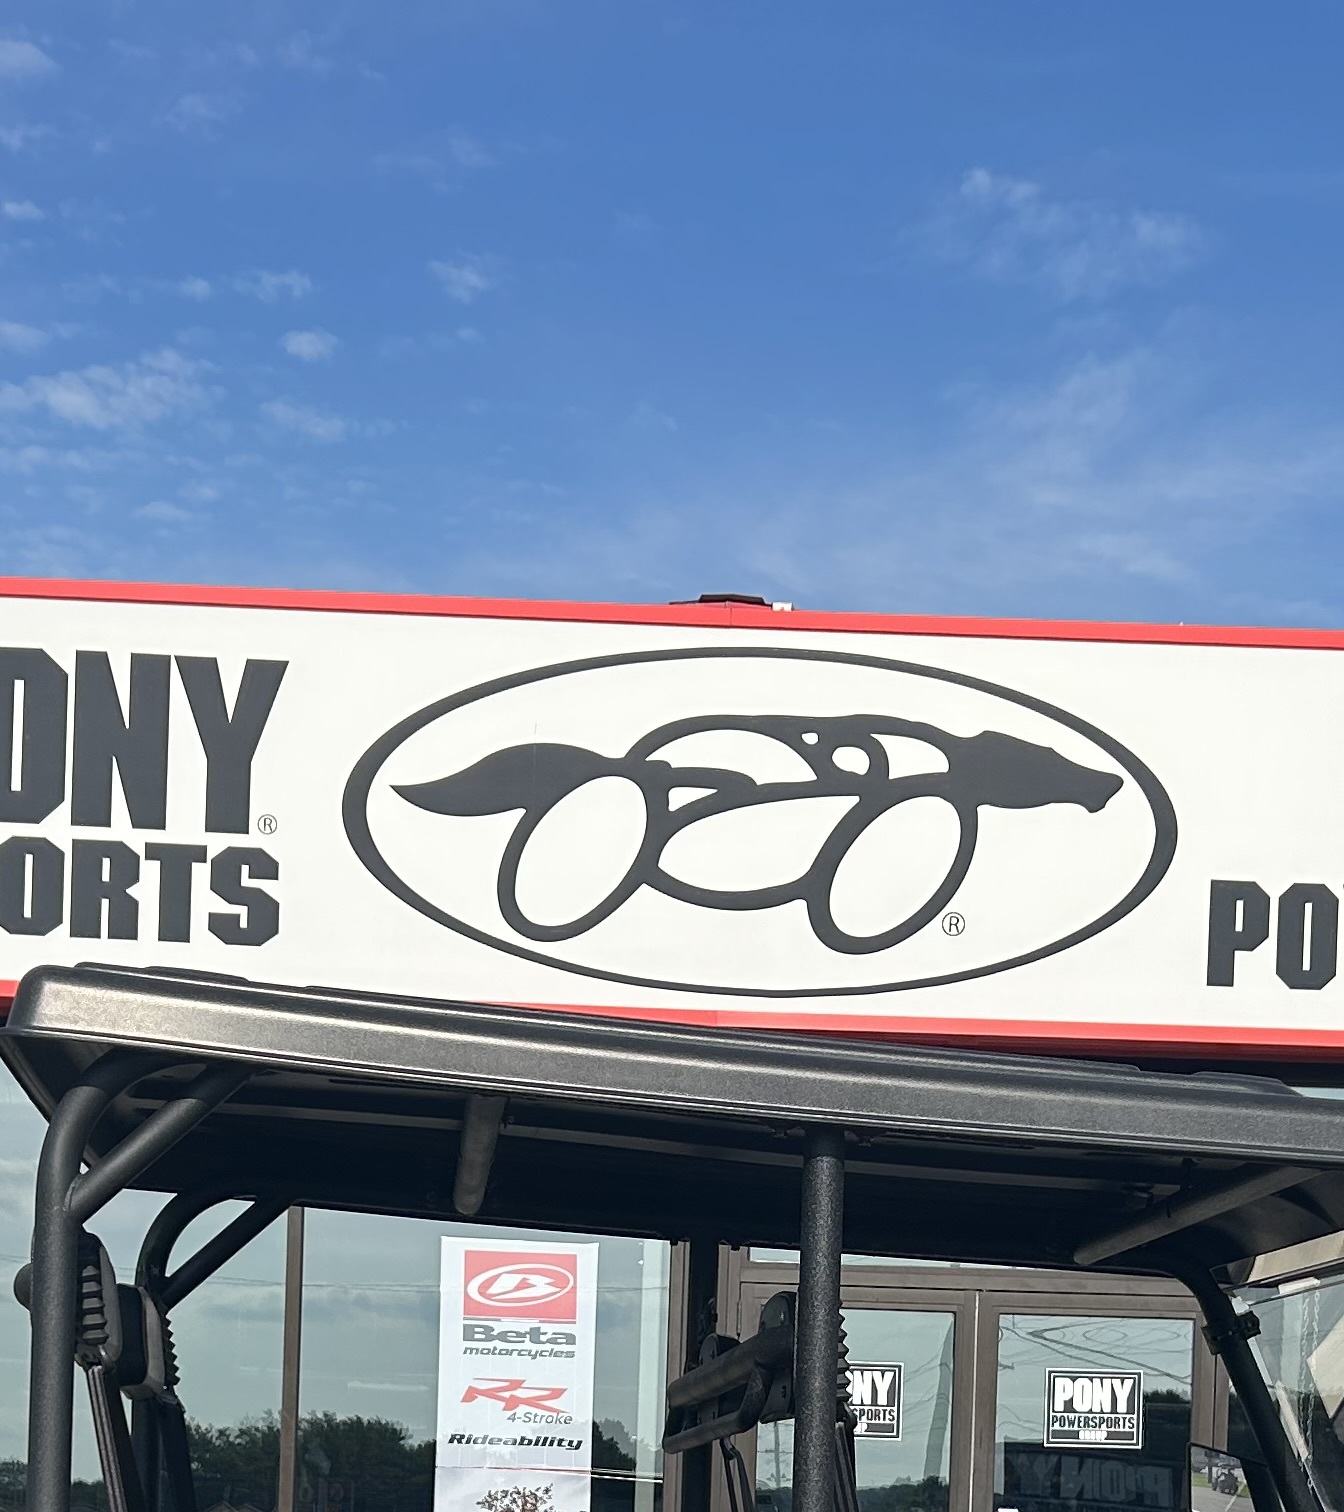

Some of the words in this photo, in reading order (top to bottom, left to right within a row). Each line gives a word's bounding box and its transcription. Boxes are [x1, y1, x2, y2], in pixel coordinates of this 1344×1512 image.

[462, 1323, 577, 1346] Beta
[462, 1346, 576, 1360] motorcycles
[845, 1370, 895, 1406] NY
[1053, 1377, 1134, 1413] PONY
[506, 1411, 574, 1426] 4-Stroke
[1051, 1414, 1135, 1430] POWERSPORTS
[447, 1433, 584, 1451] Rideability
